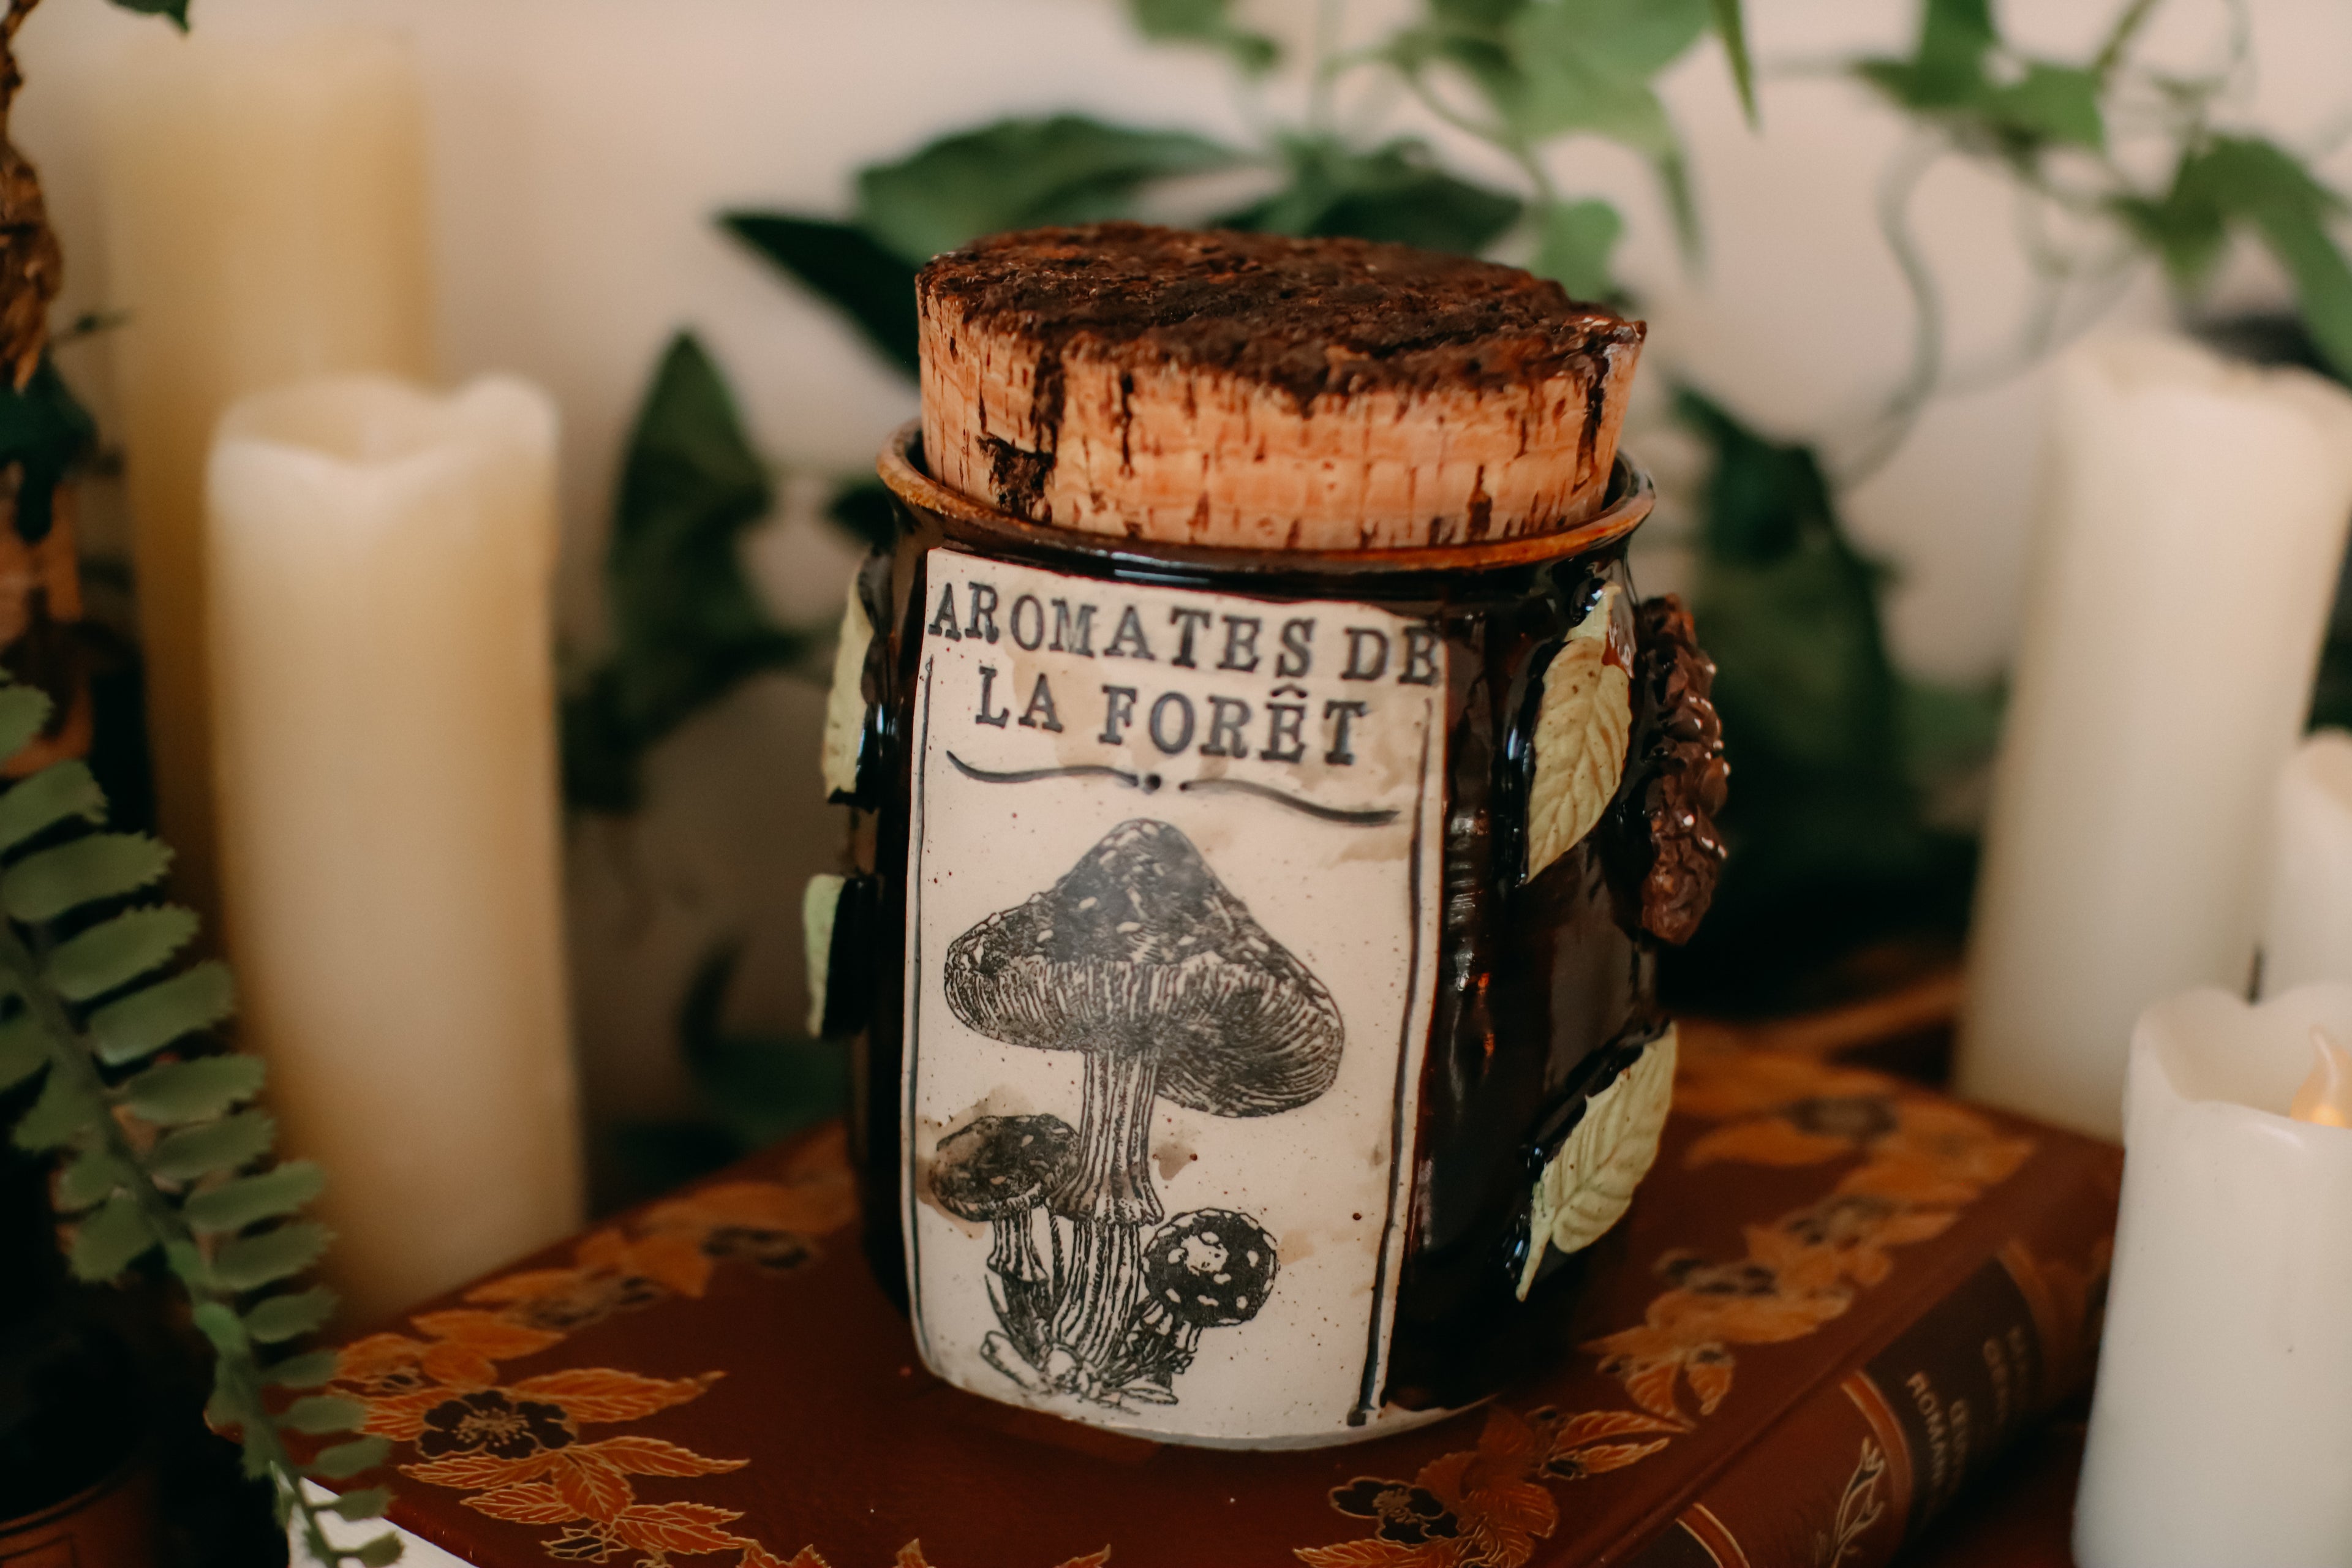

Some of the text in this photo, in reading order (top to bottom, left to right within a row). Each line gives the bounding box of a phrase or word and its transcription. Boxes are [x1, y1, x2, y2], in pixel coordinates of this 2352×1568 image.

[927, 581, 1441, 686] AROMATES DE
[975, 665, 1366, 766] LA FORÊT
